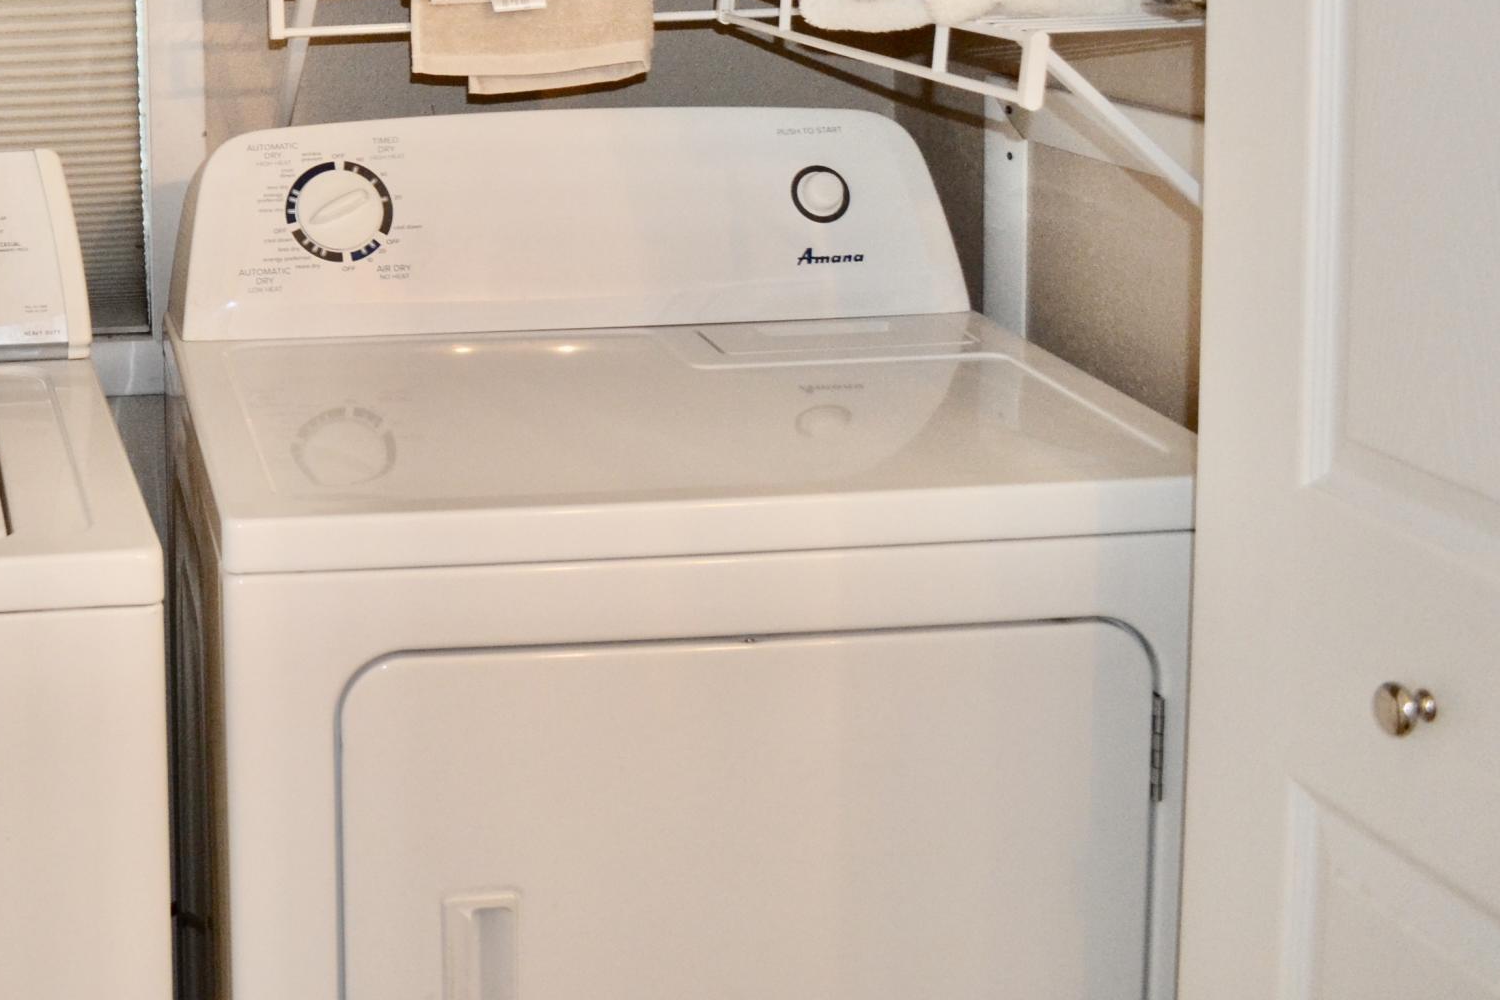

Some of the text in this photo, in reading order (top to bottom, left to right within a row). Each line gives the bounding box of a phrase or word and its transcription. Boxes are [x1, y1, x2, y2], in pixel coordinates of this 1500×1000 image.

[776, 126, 842, 136] PUSH TO START
[372, 136, 399, 144] TIMED
[246, 142, 299, 152] AUTOMATIC
[377, 145, 395, 153] DRY
[797, 247, 865, 266] Amana
[238, 267, 291, 276] AUTOMATIC
[393, 264, 411, 272] DRY
[255, 277, 274, 285] DRY
